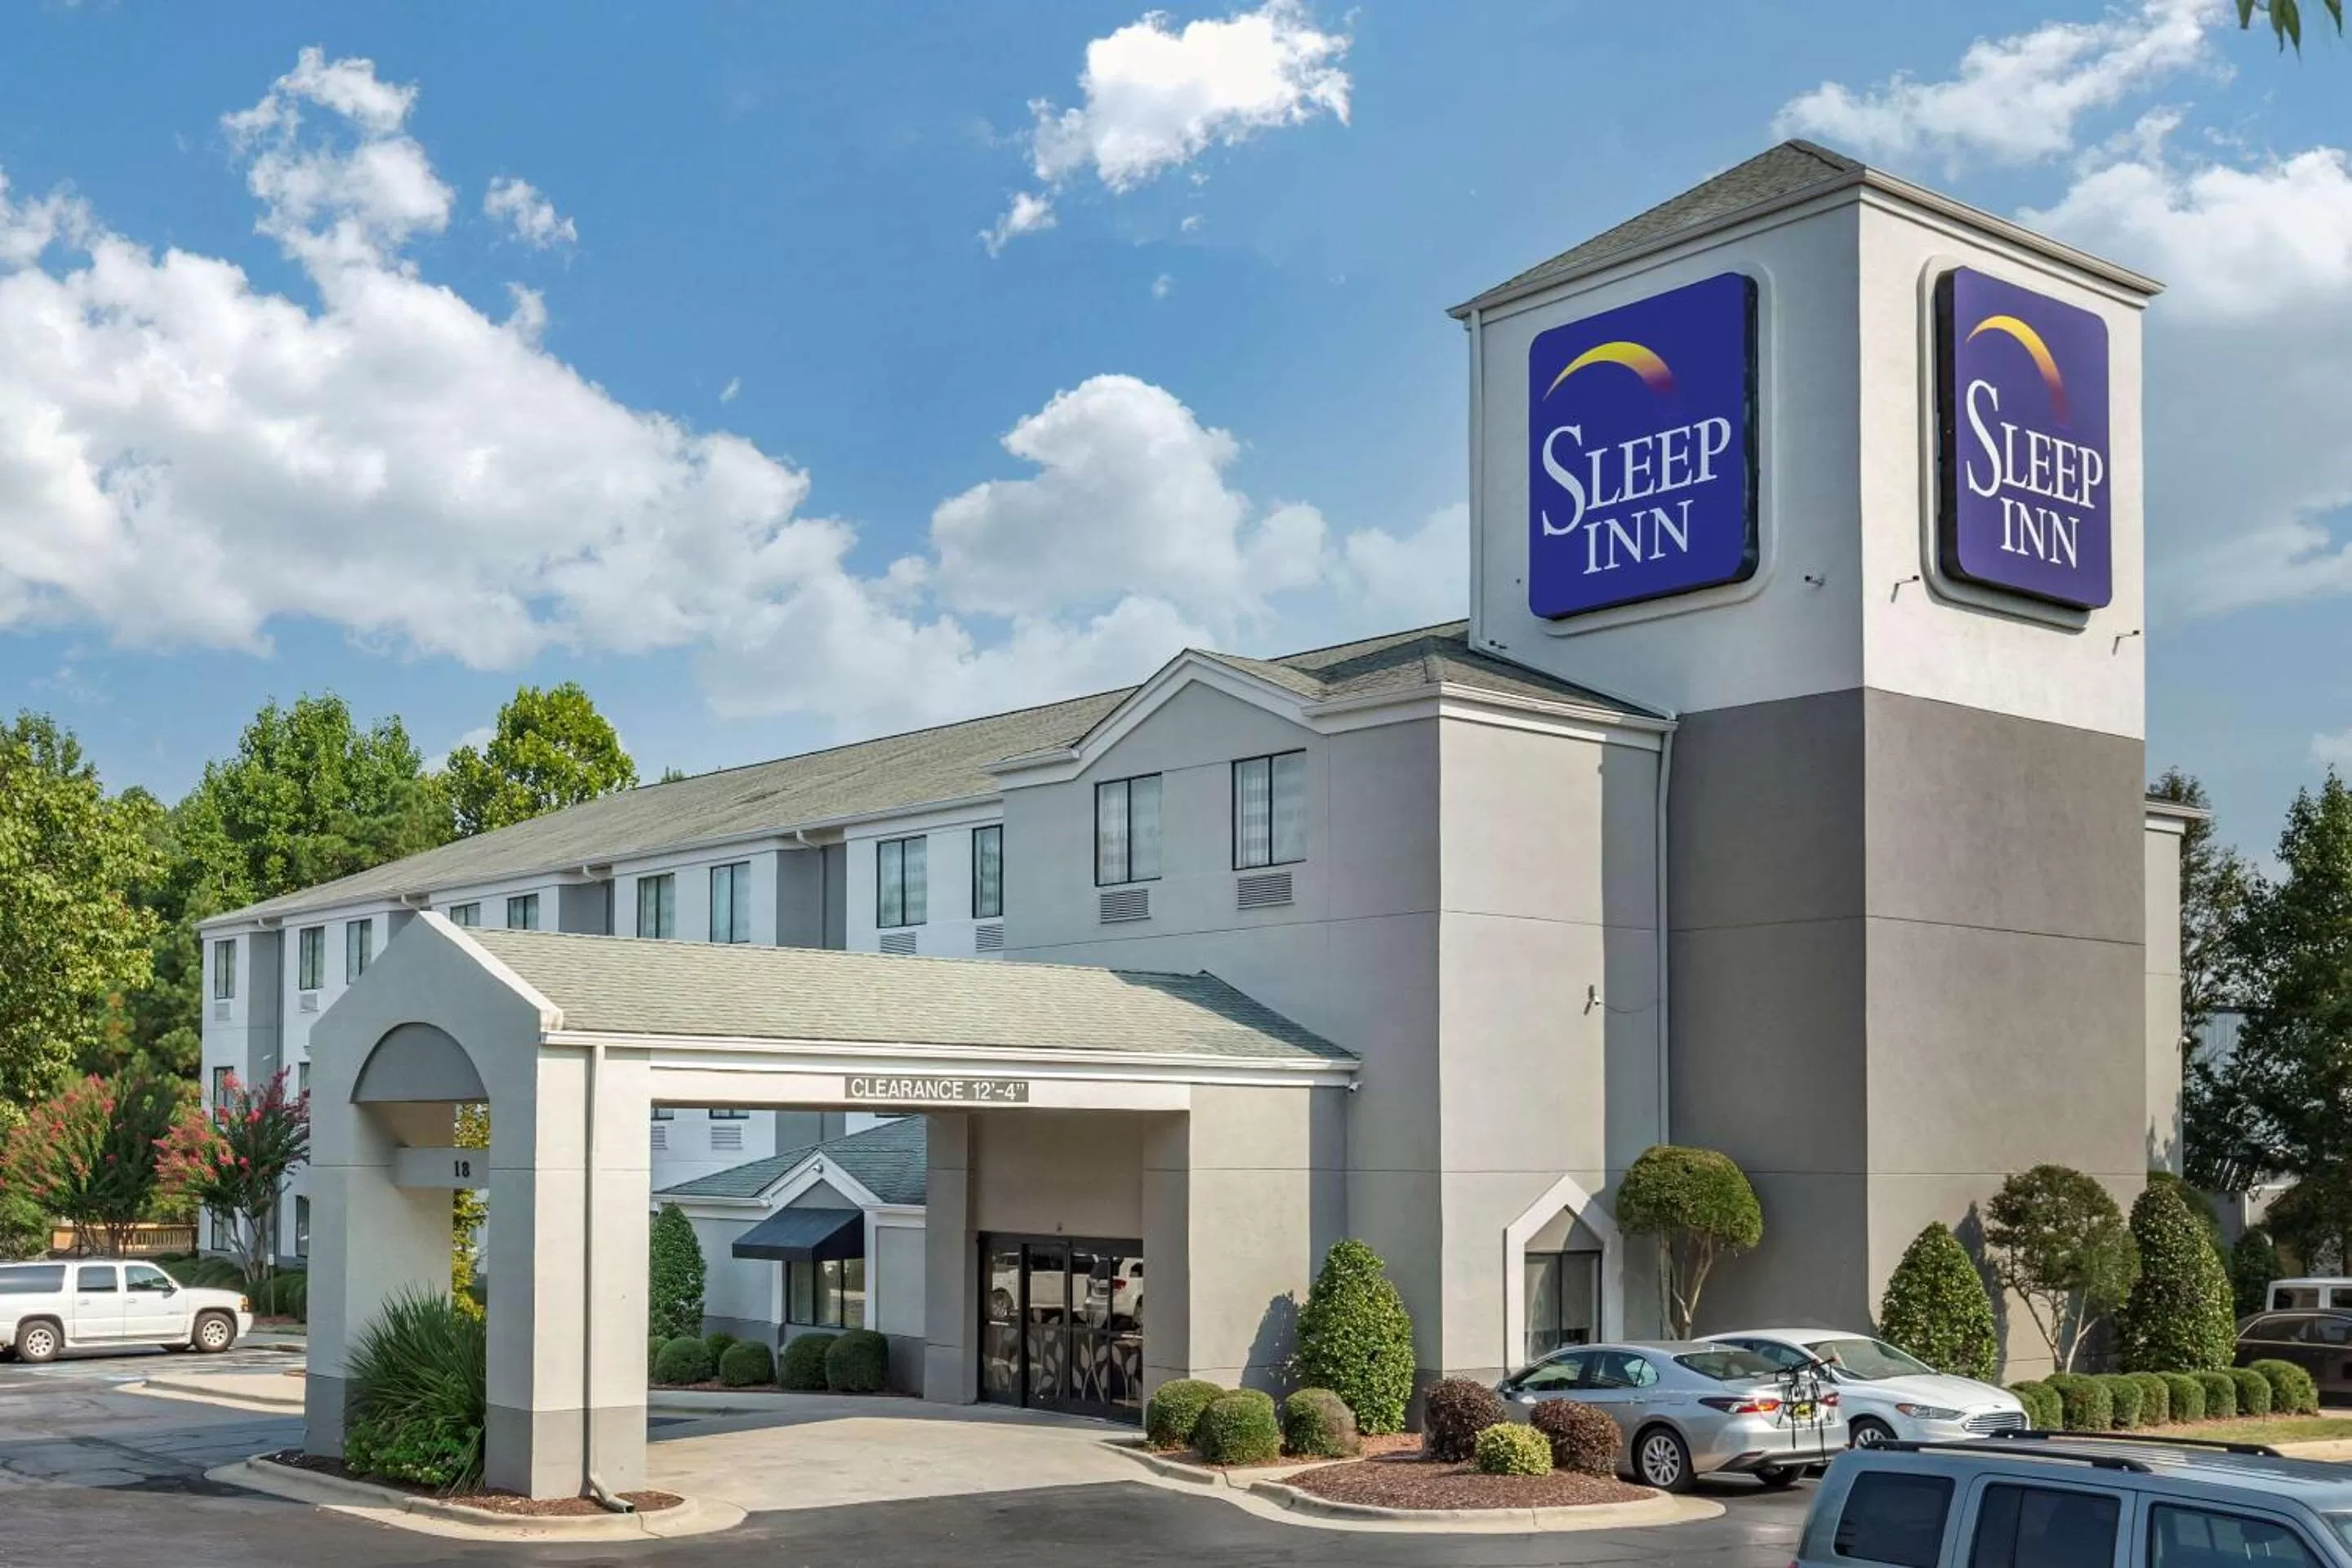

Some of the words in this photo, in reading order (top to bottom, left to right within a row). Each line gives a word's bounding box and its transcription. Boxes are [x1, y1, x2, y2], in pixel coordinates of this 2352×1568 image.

[1542, 416, 1731, 537] SLEEP
[1967, 379, 2104, 509] SLEEP
[1583, 500, 1694, 575] INN
[2000, 497, 2080, 569] INN
[851, 1078, 964, 1099] CLEARANCE
[454, 1160, 470, 1178] 18
